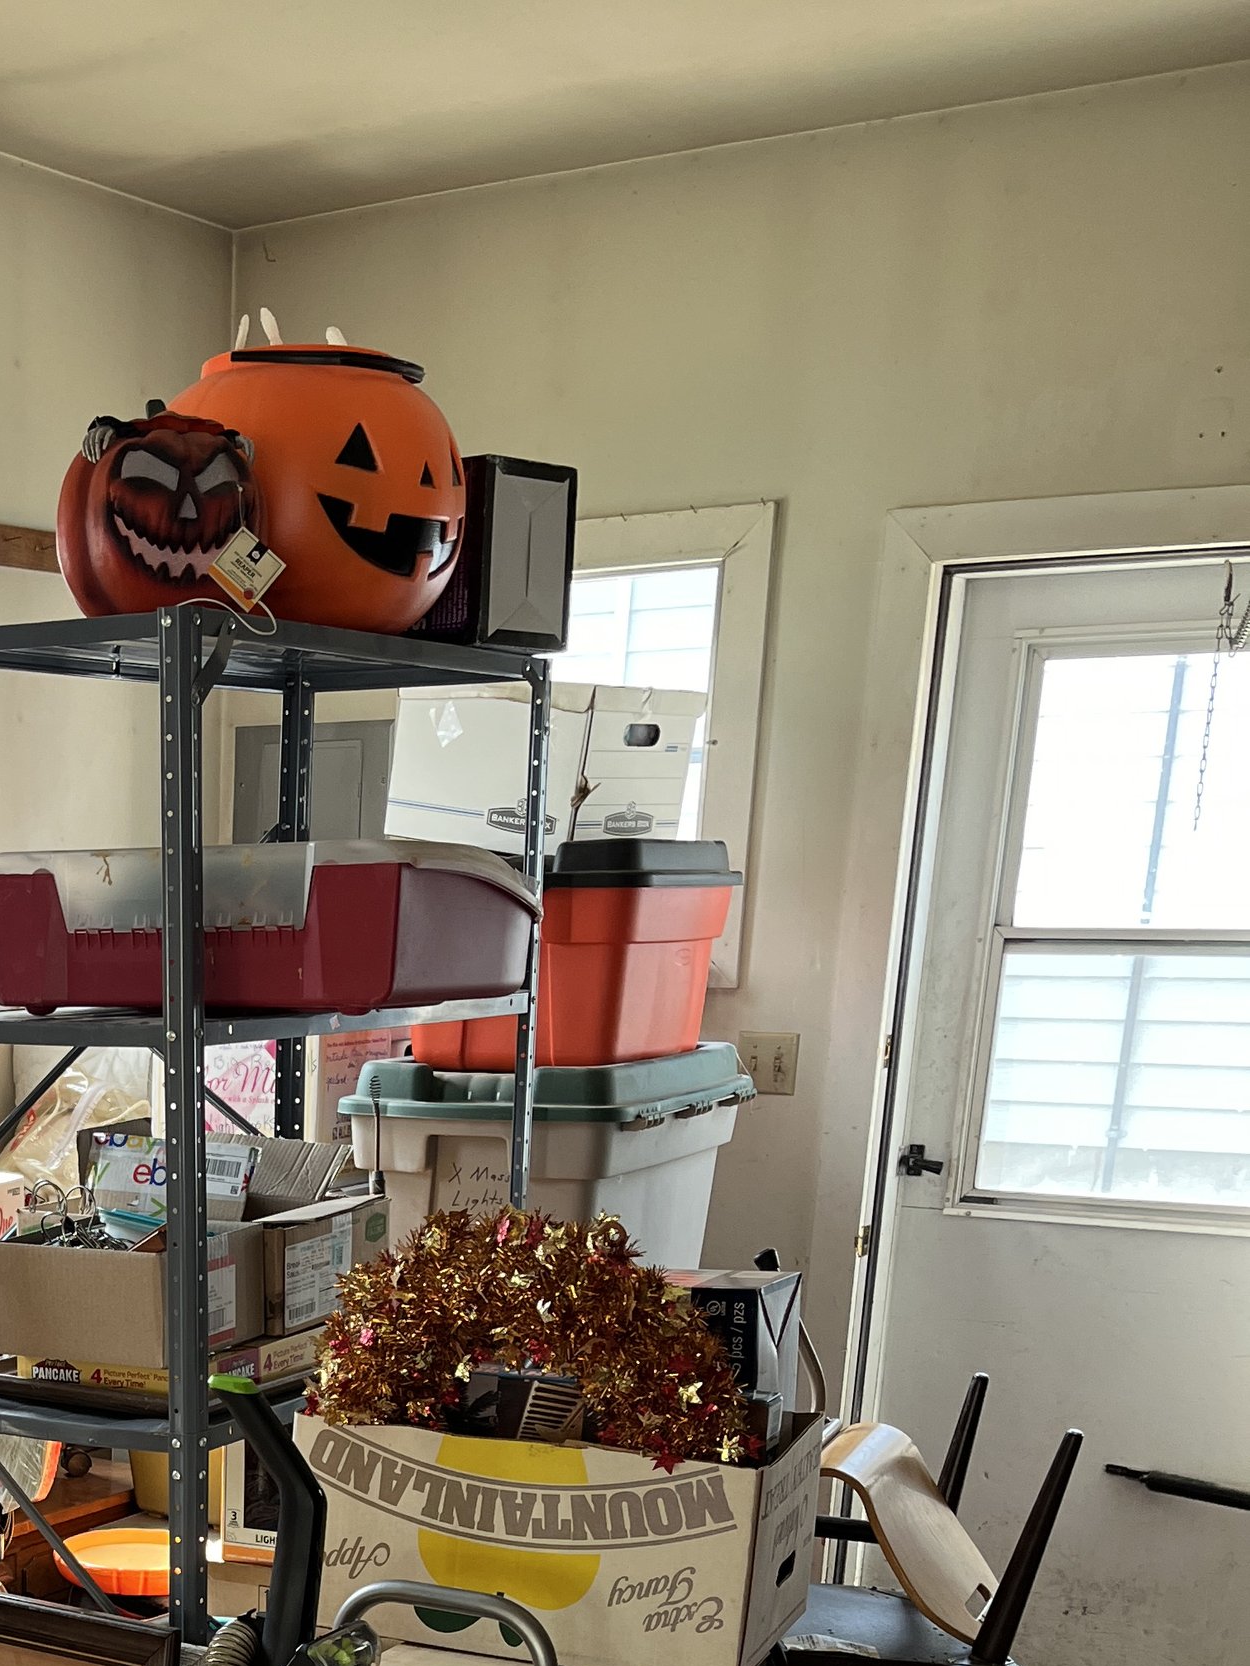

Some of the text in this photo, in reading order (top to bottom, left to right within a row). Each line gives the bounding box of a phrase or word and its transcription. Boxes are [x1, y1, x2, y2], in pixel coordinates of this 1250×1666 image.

[491, 813, 526, 826] BANKER
[606, 820, 636, 829] BANKERS
[133, 1158, 167, 1187] eb
[448, 1162, 511, 1185] X Mass
[451, 1188, 503, 1211] Lights
[732, 1302, 747, 1325] pzs
[729, 1336, 745, 1359] pcs
[44, 1359, 66, 1368] Perfect
[224, 1363, 255, 1377] ANCAKE
[263, 1353, 273, 1372] 4
[273, 1358, 290, 1371] Every
[32, 1366, 80, 1383] PANCAKE
[90, 1368, 103, 1385] 4
[103, 1369, 126, 1379] Picture
[153, 1373, 169, 1382] Panc
[103, 1379, 125, 1389] Every
[309, 1428, 737, 1541] MOUNTAINLAND
[230, 1510, 238, 1521] 3
[255, 1533, 277, 1546] LIGH
[323, 1537, 391, 1580] App
[607, 1567, 696, 1608] Fancy
[643, 1596, 725, 1634] Extra
